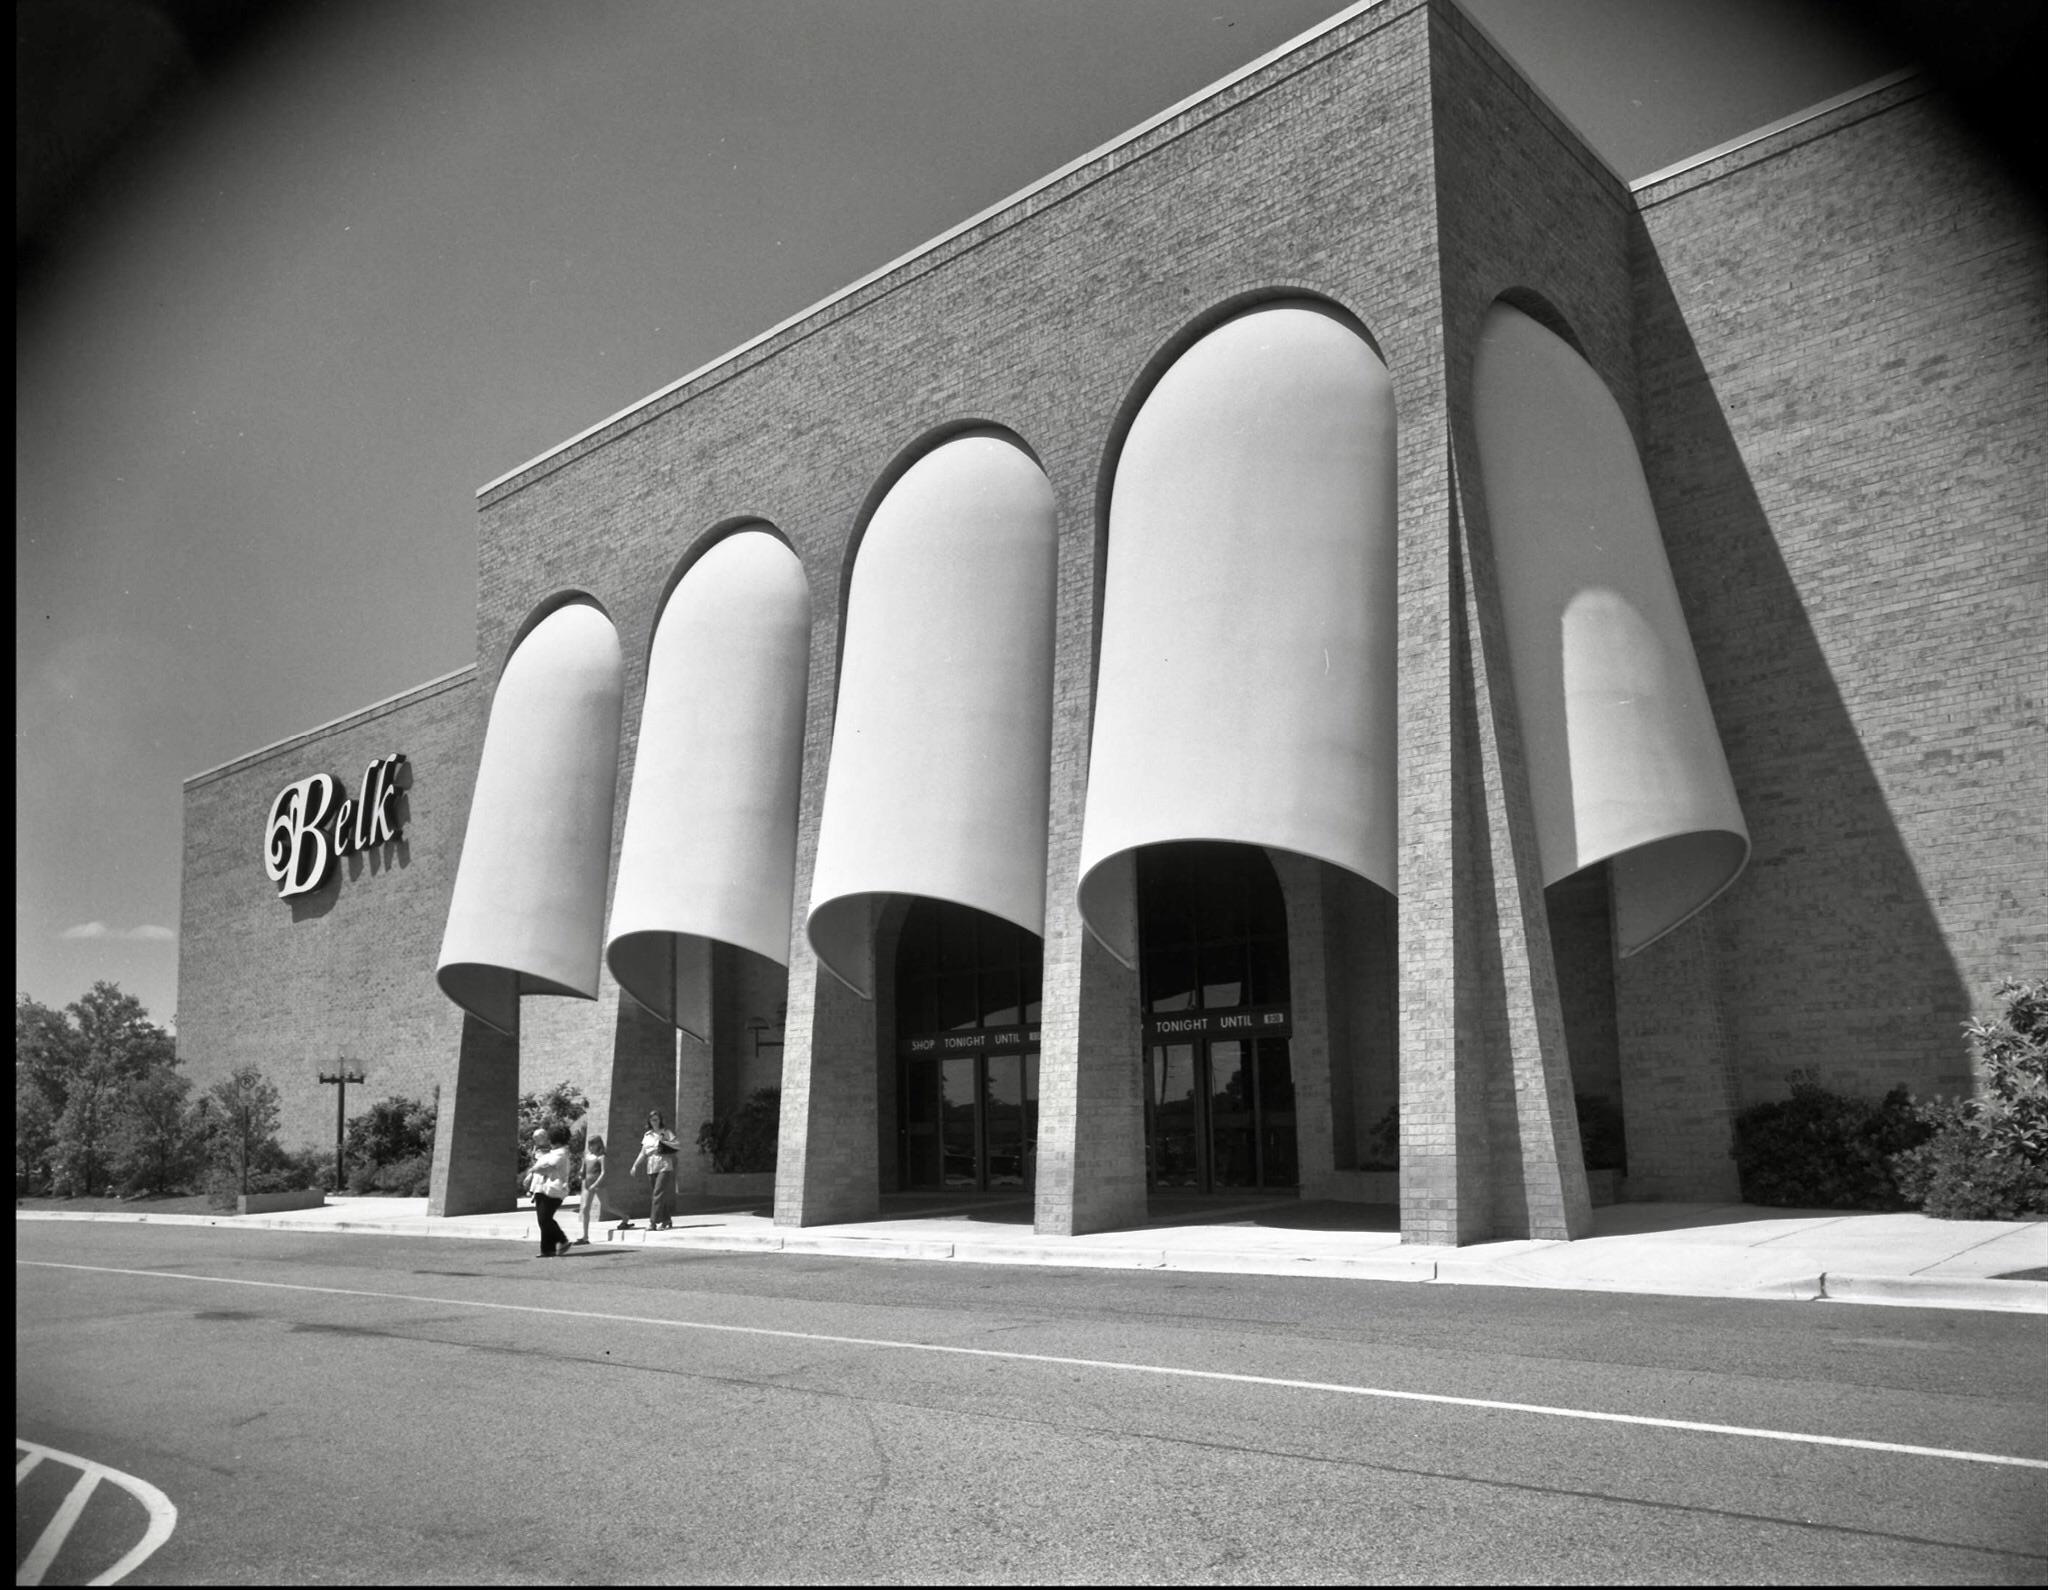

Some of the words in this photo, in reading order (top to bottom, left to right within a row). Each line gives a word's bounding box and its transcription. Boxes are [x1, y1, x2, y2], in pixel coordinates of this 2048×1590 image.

[264, 753, 396, 898] Belk
[1156, 1018, 1208, 1033] TONIGHT
[1220, 1015, 1253, 1028] UNTIL
[911, 1039, 935, 1051] SHOP
[944, 1035, 986, 1049] TONIGHT
[994, 1033, 1020, 1045] UNTIL
